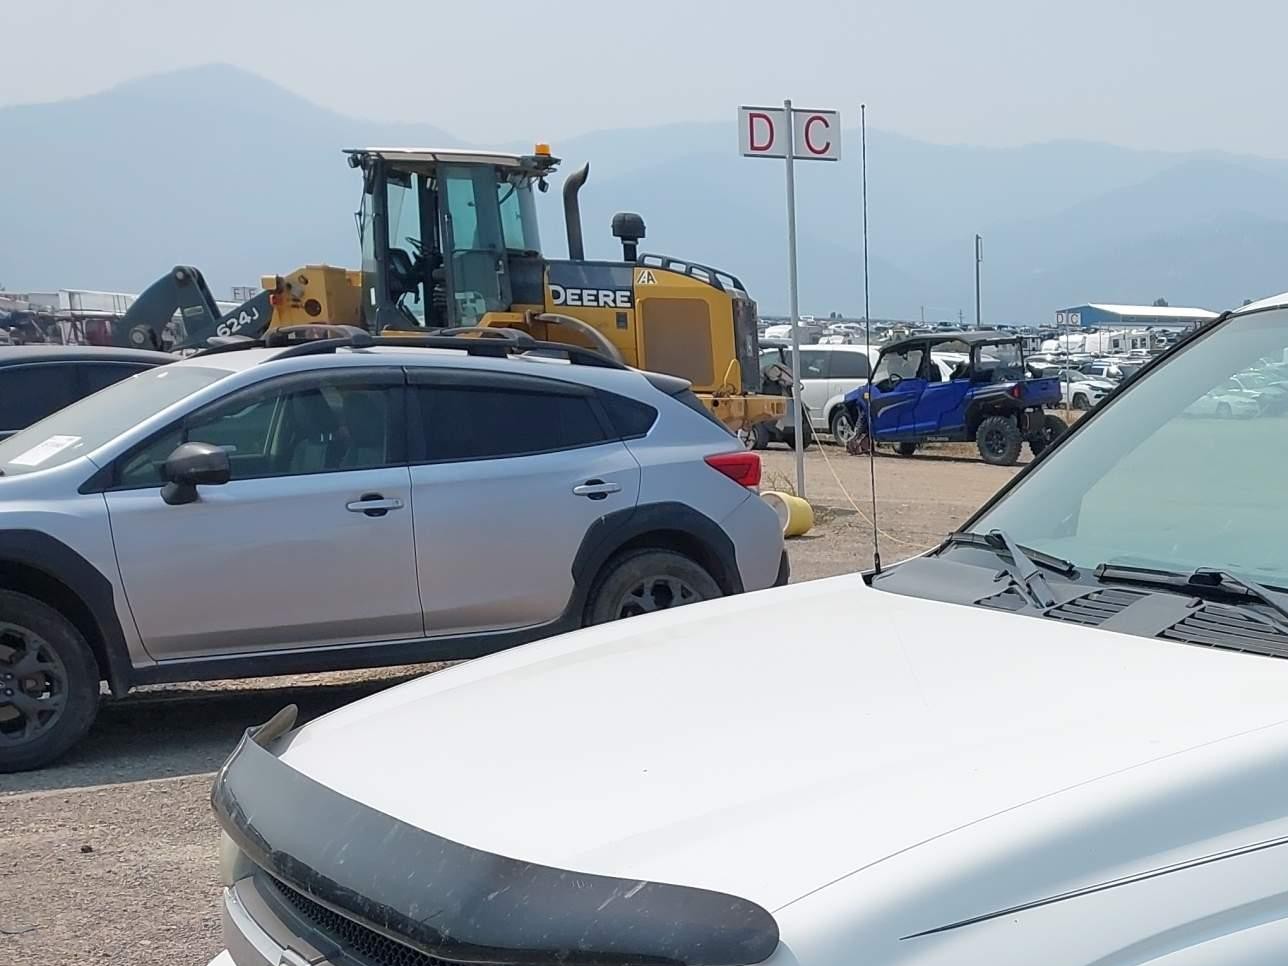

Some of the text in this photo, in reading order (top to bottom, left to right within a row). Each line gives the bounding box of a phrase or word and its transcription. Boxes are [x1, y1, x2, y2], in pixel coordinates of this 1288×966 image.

[749, 112, 831, 155] D C
[548, 284, 632, 308] DEERE
[216, 307, 259, 337] 624J
[1057, 313, 1078, 324] D C
